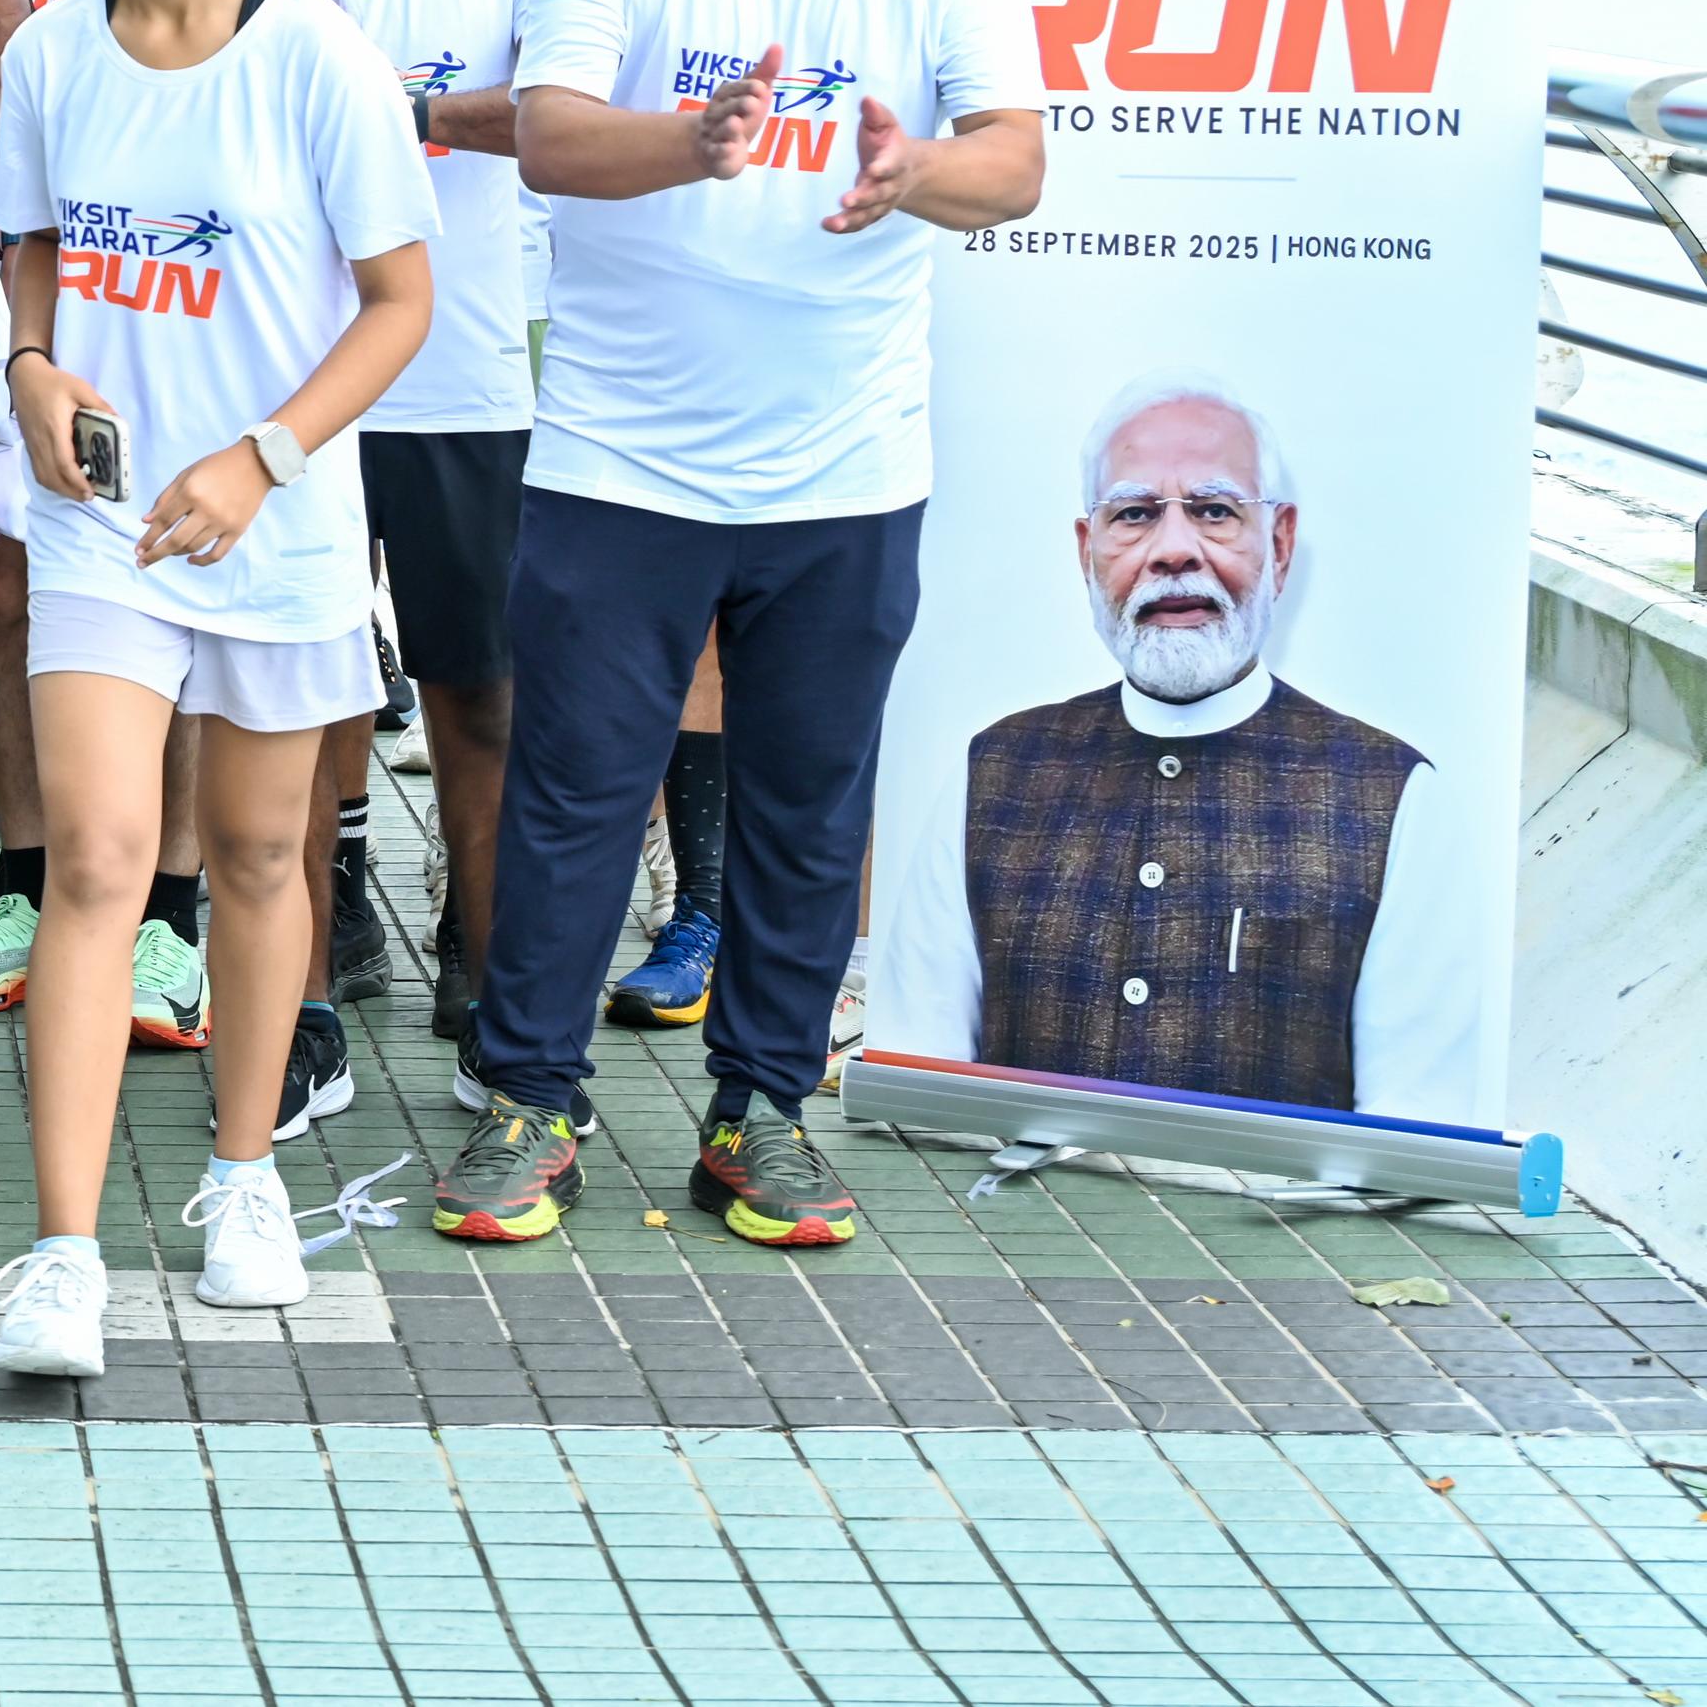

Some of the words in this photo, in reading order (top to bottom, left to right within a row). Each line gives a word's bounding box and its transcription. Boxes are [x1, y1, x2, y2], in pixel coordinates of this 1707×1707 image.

[681, 48, 763, 80] VIKSI
[1048, 105, 1095, 132] TO
[1111, 105, 1223, 134] SERVE
[1239, 107, 1302, 136] THE
[1318, 108, 1460, 137] NATION
[59, 198, 132, 228] IKSIT
[63, 224, 159, 256] HARAT
[964, 230, 997, 252] 28
[1009, 231, 1177, 257] SEPTEMBER
[1189, 235, 1259, 259] 2025
[1287, 236, 1357, 258] HONG
[1363, 238, 1432, 260] KONG
[59, 248, 221, 319] RUN
